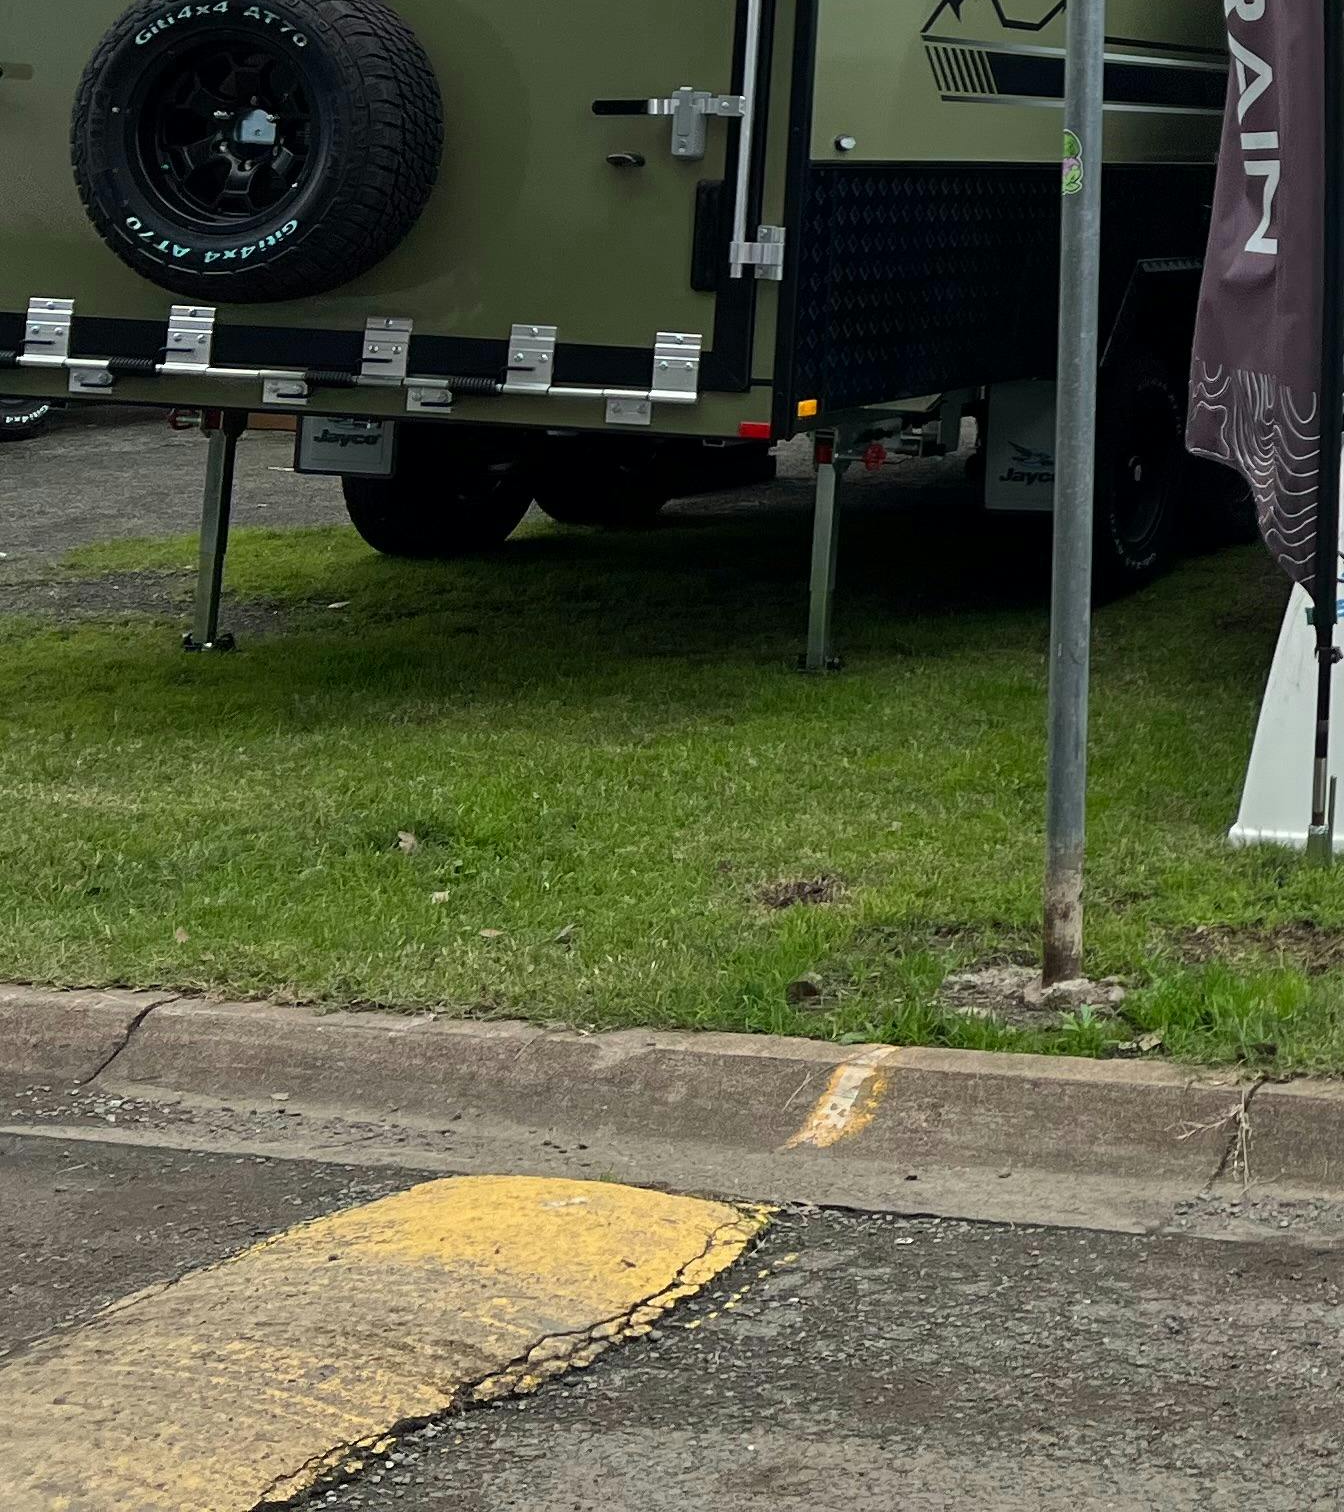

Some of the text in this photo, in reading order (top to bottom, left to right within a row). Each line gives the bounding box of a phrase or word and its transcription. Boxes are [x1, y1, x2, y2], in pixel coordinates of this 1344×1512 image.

[134, 0, 308, 48] Giti4x4 AT70
[126, 216, 297, 263] Giti4x4 AT70
[313, 429, 381, 448] Jayco
[999, 467, 1056, 486] Jayc
